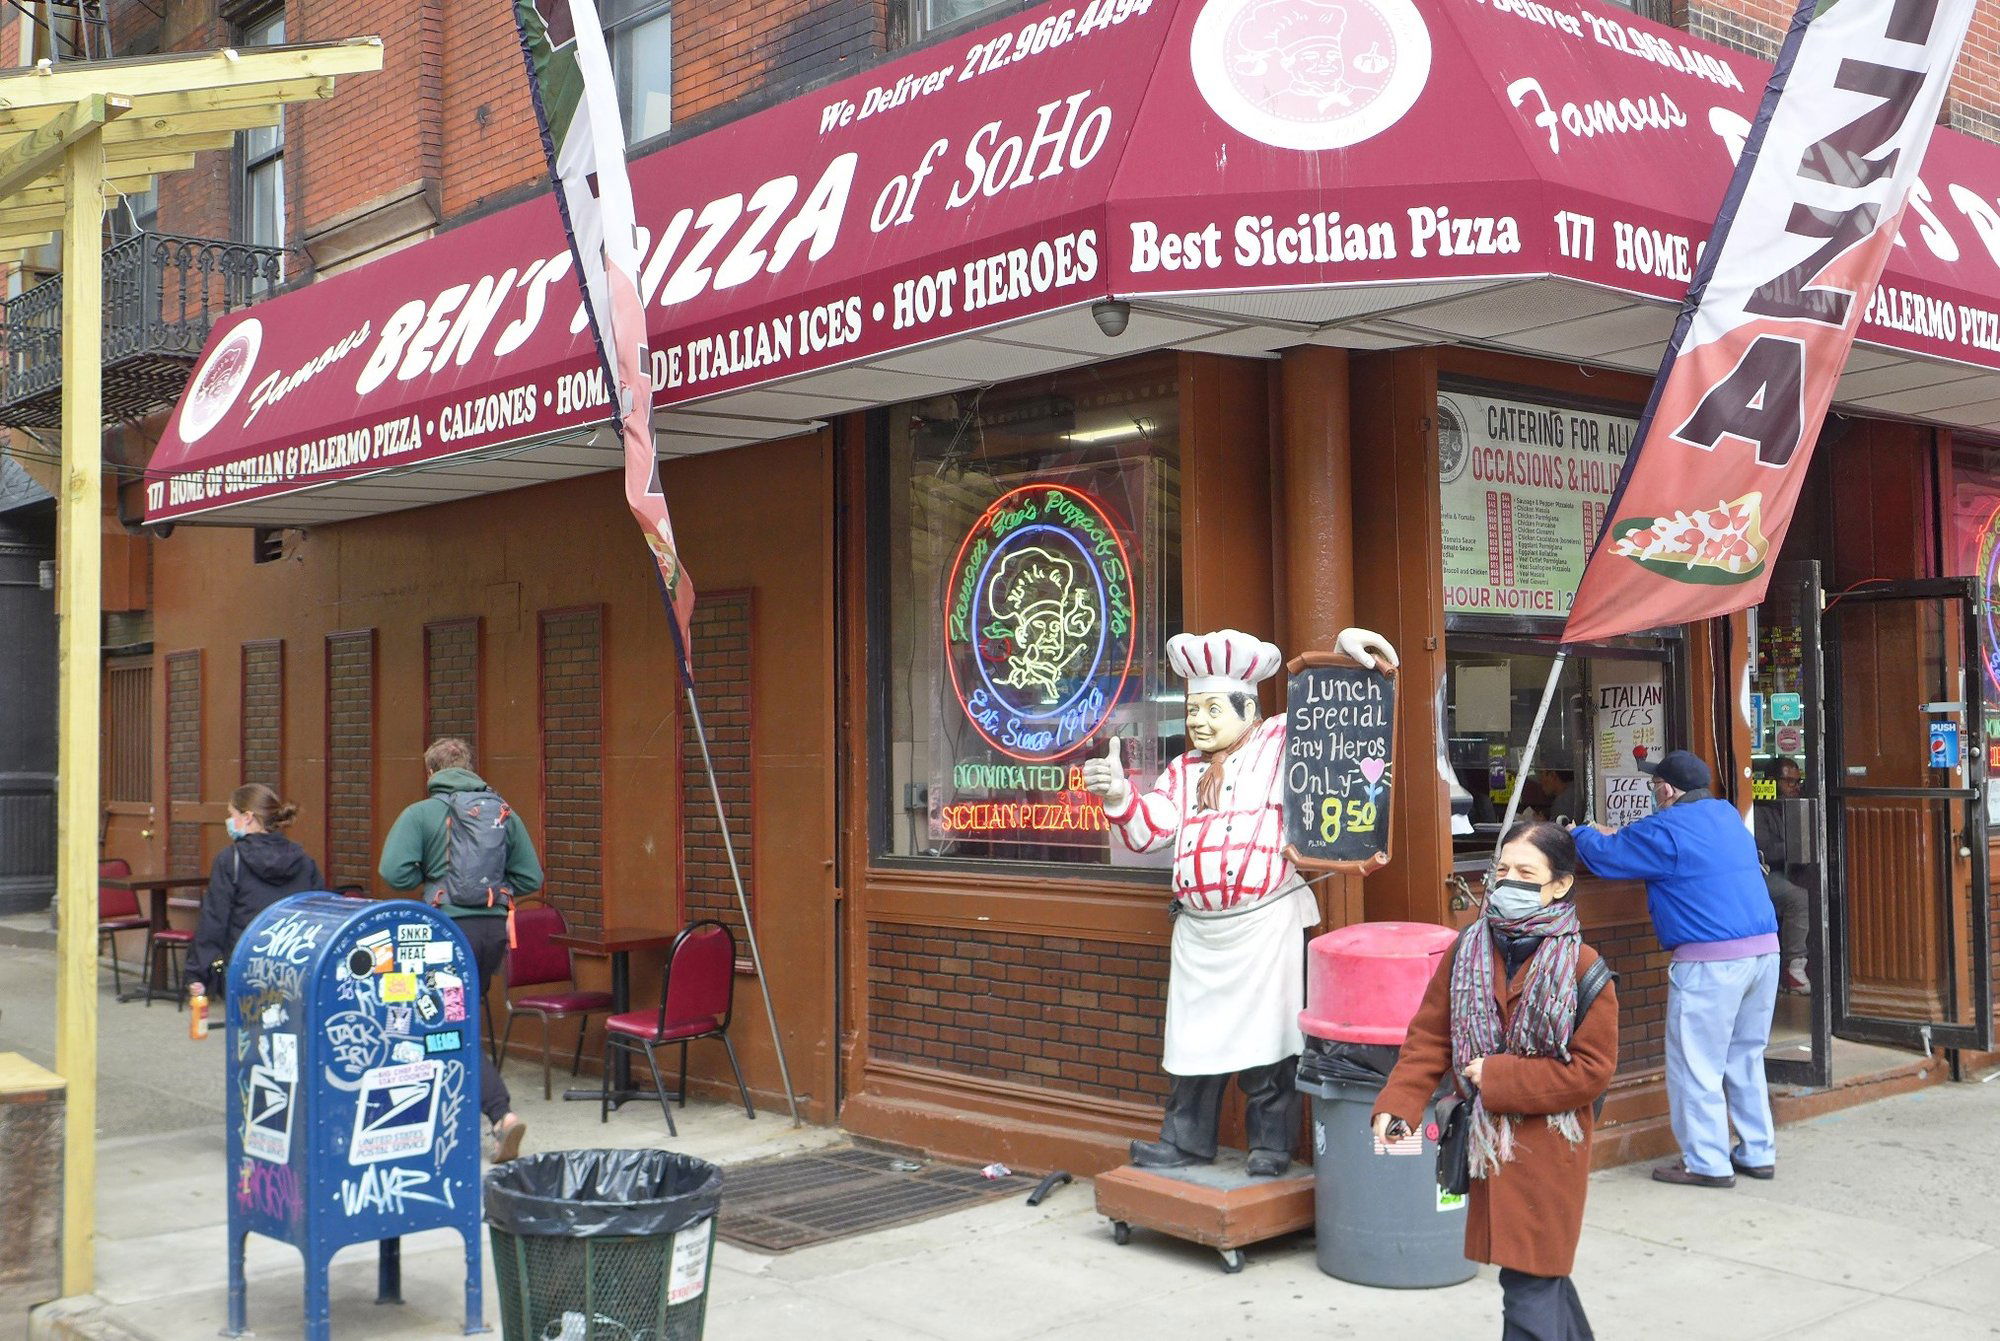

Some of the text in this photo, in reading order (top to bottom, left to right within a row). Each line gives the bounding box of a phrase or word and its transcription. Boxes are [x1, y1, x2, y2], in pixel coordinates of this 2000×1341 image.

[1581, 10, 1745, 93] 212.966.4494
[819, 0, 1152, 135] We Deliver 212.966.4494
[1507, 77, 1687, 155] Famous
[1130, 205, 1521, 272] Best Sicilian Pizza
[244, 319, 372, 429] Famous
[357, 249, 574, 396] BEN'S
[870, 138, 948, 233] of
[945, 90, 1113, 210] SoHo
[1554, 210, 1594, 261] 177
[1613, 221, 1692, 282] HOME
[1864, 284, 1956, 342] PALERMO
[1959, 306, 2000, 351] PIZZ
[147, 481, 163, 511] 177
[169, 471, 203, 507] HOME
[203, 466, 225, 500] OF
[225, 454, 284, 496] SICILIAN
[286, 451, 299, 477] &
[300, 434, 372, 477] PALERMO
[373, 420, 423, 462] PIZZA
[438, 384, 538, 443] CALZONES
[687, 314, 793, 384] ITALIAN
[798, 296, 862, 356] ICES
[893, 267, 957, 330] HOT
[962, 229, 1098, 312] HEROES
[1487, 405, 1564, 448] CATERING
[1571, 418, 1599, 452] FOR
[1472, 446, 1563, 490] OCCASIONS
[1567, 457, 1579, 491] &
[1444, 586, 1490, 608] HOUR
[1495, 588, 1554, 610] NOTICE
[1306, 674, 1382, 704] Lunch
[1600, 685, 1662, 709] ITALIAN
[1610, 708, 1653, 728] ICE'S
[1931, 723, 1956, 731] PUSH
[1290, 732, 1386, 761] any Heros
[953, 764, 1064, 791] NOMINATED
[1611, 778, 1641, 793] ICE
[1607, 795, 1650, 809] COFFEE
[942, 803, 1017, 831] SICILIAN
[1020, 804, 1076, 830] PIZZA
[401, 928, 428, 939] SNKR
